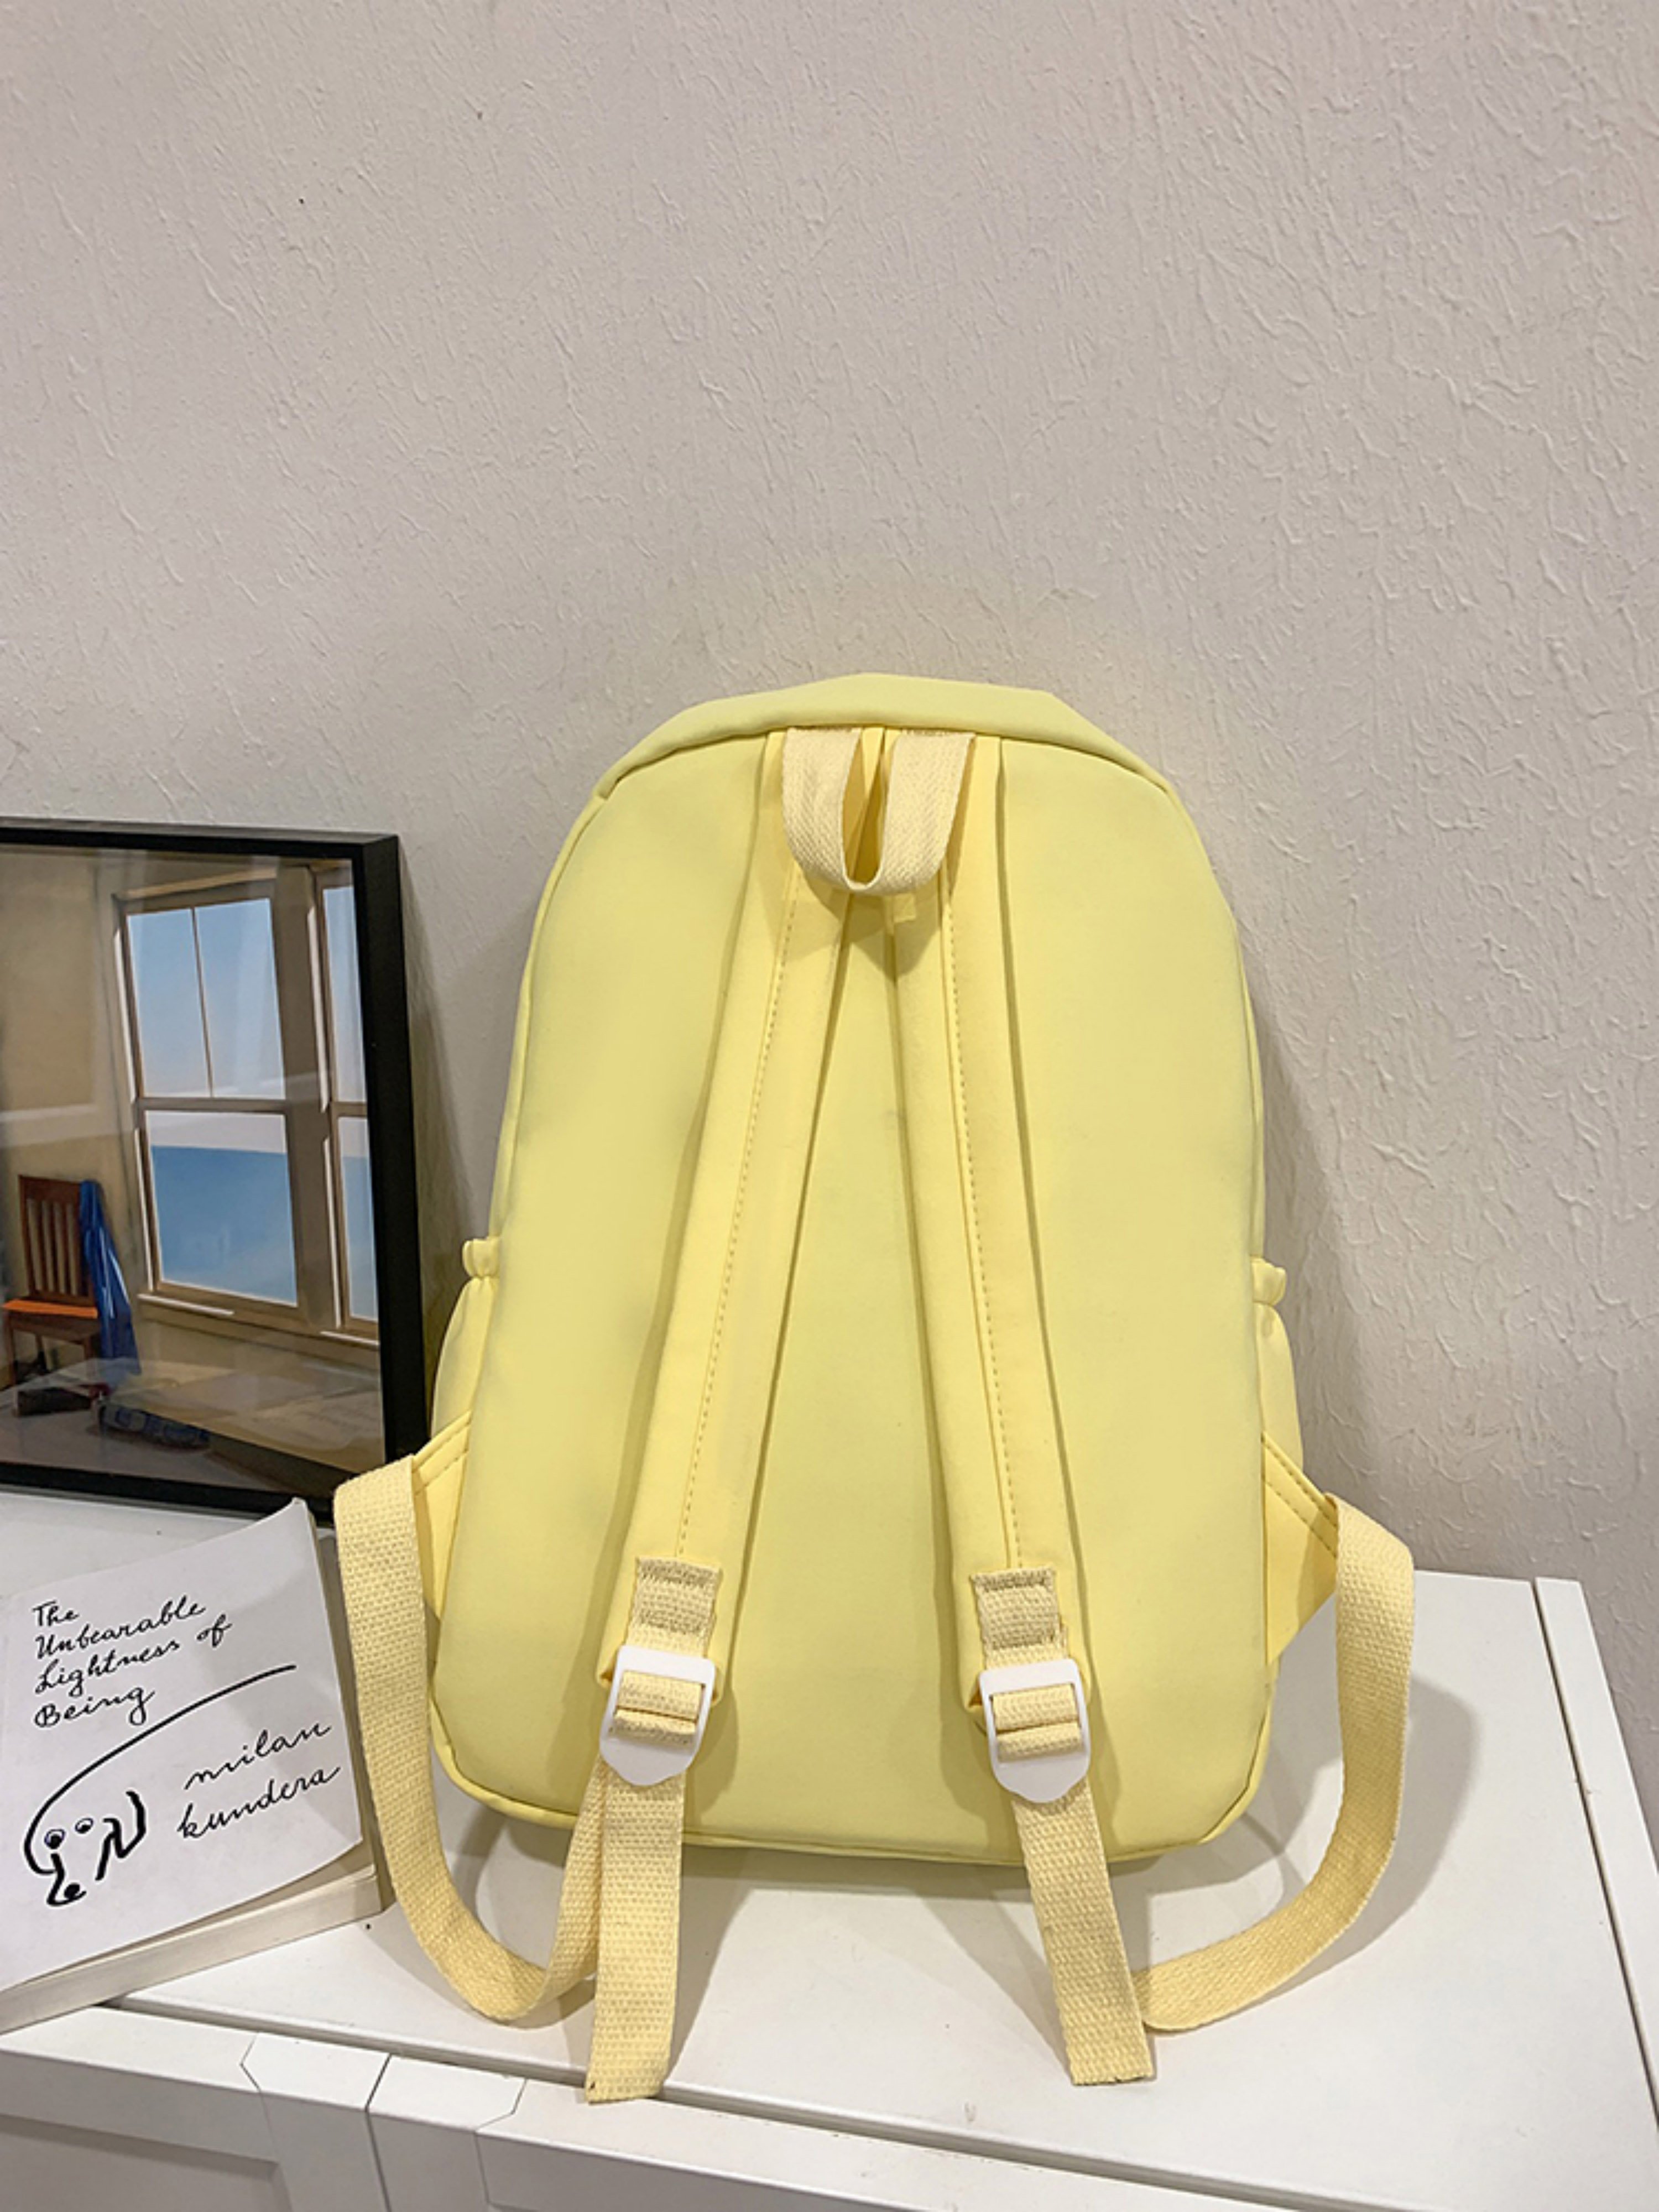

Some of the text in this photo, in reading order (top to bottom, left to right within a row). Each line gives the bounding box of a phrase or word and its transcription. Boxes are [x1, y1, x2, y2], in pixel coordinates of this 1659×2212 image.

[33, 1601, 79, 1627] The
[35, 1595, 206, 1659] Unbearable
[34, 1614, 232, 1694] Lightness of
[34, 1686, 155, 1728] Being
[184, 1724, 331, 1790] milan
[177, 1767, 341, 1839] kundera
